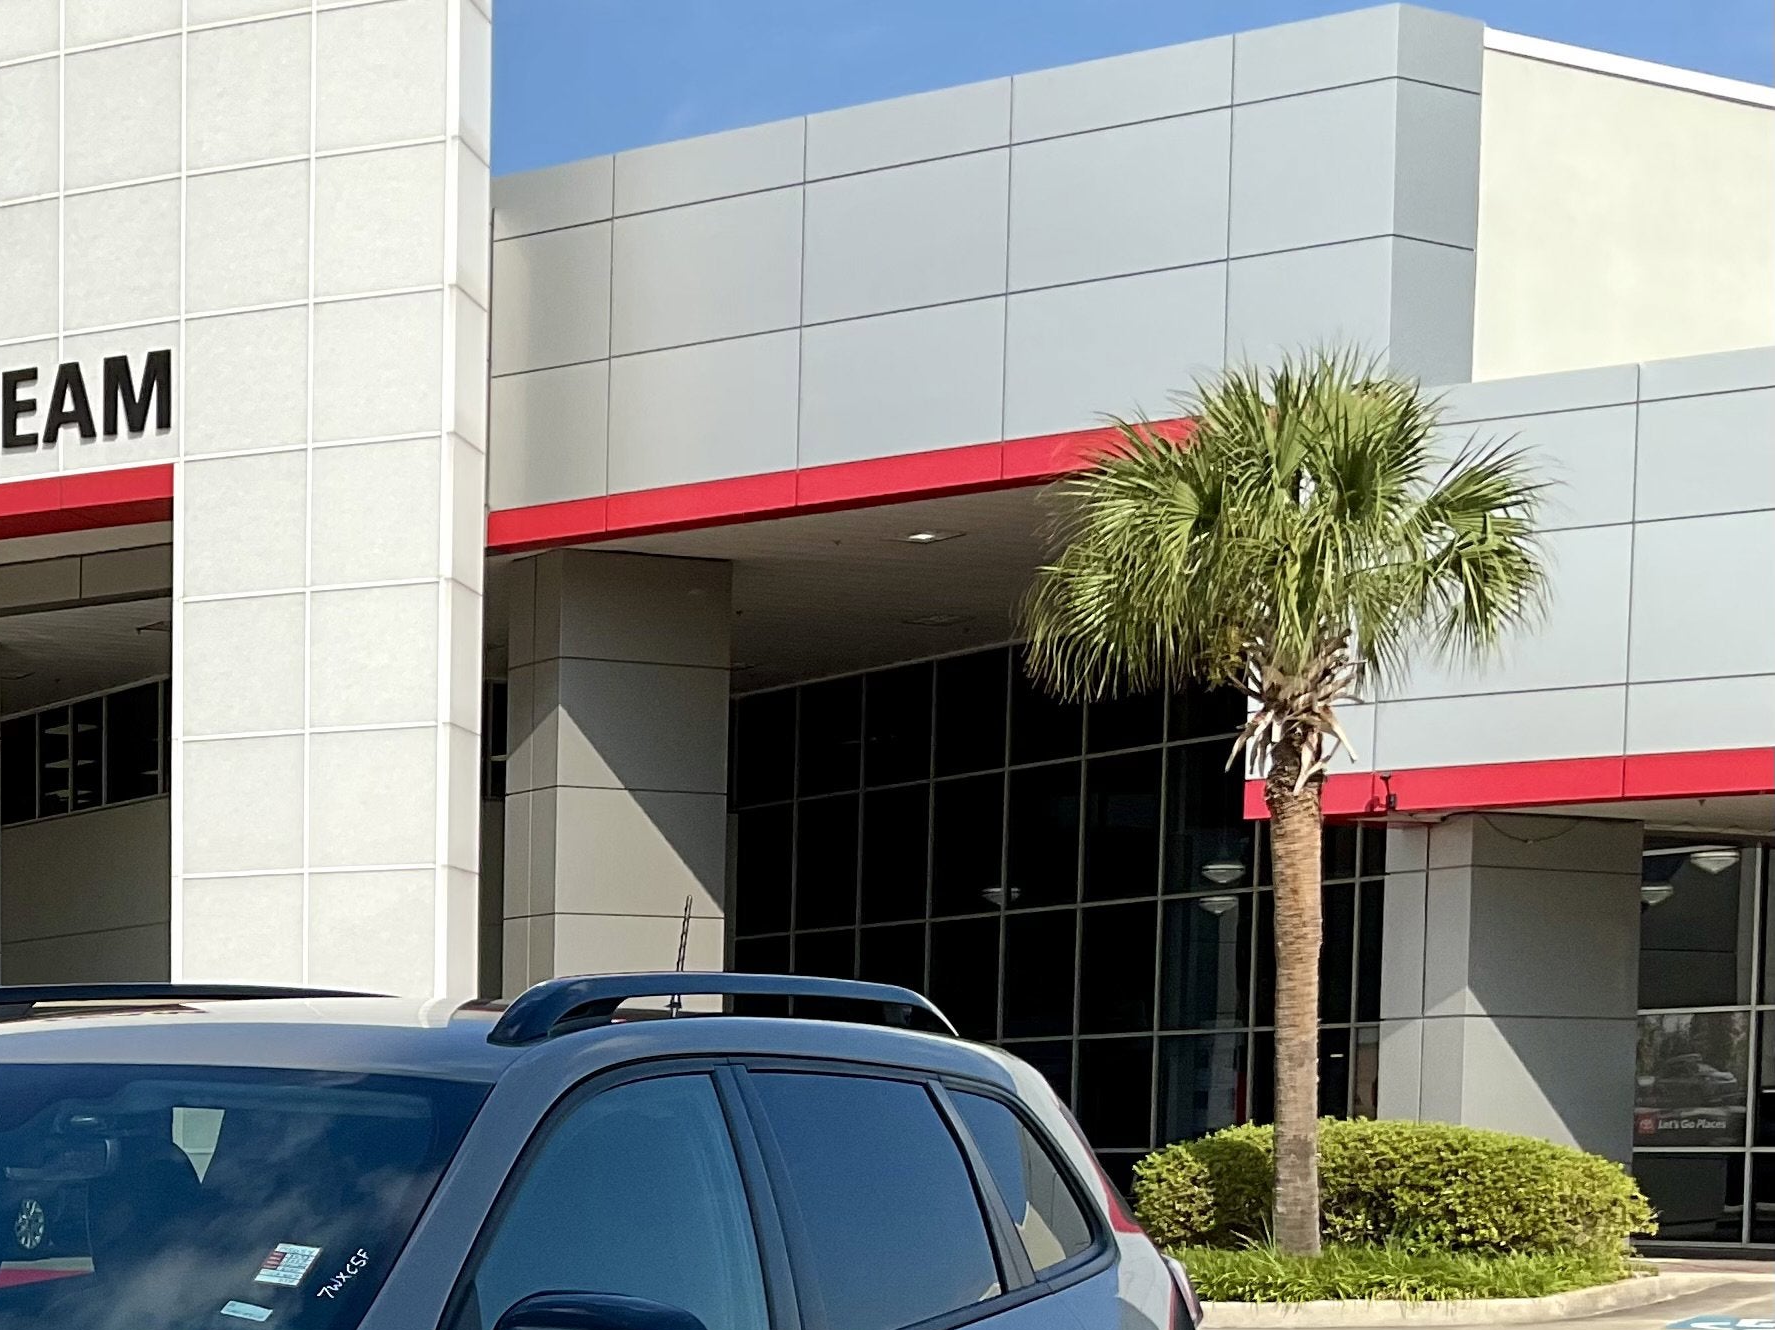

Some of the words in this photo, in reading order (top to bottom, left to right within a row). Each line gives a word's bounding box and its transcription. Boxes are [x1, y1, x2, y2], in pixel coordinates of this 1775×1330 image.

[1658, 1119, 1679, 1130] Let's
[1680, 1119, 1695, 1129] Go
[1696, 1118, 1727, 1129] Places
